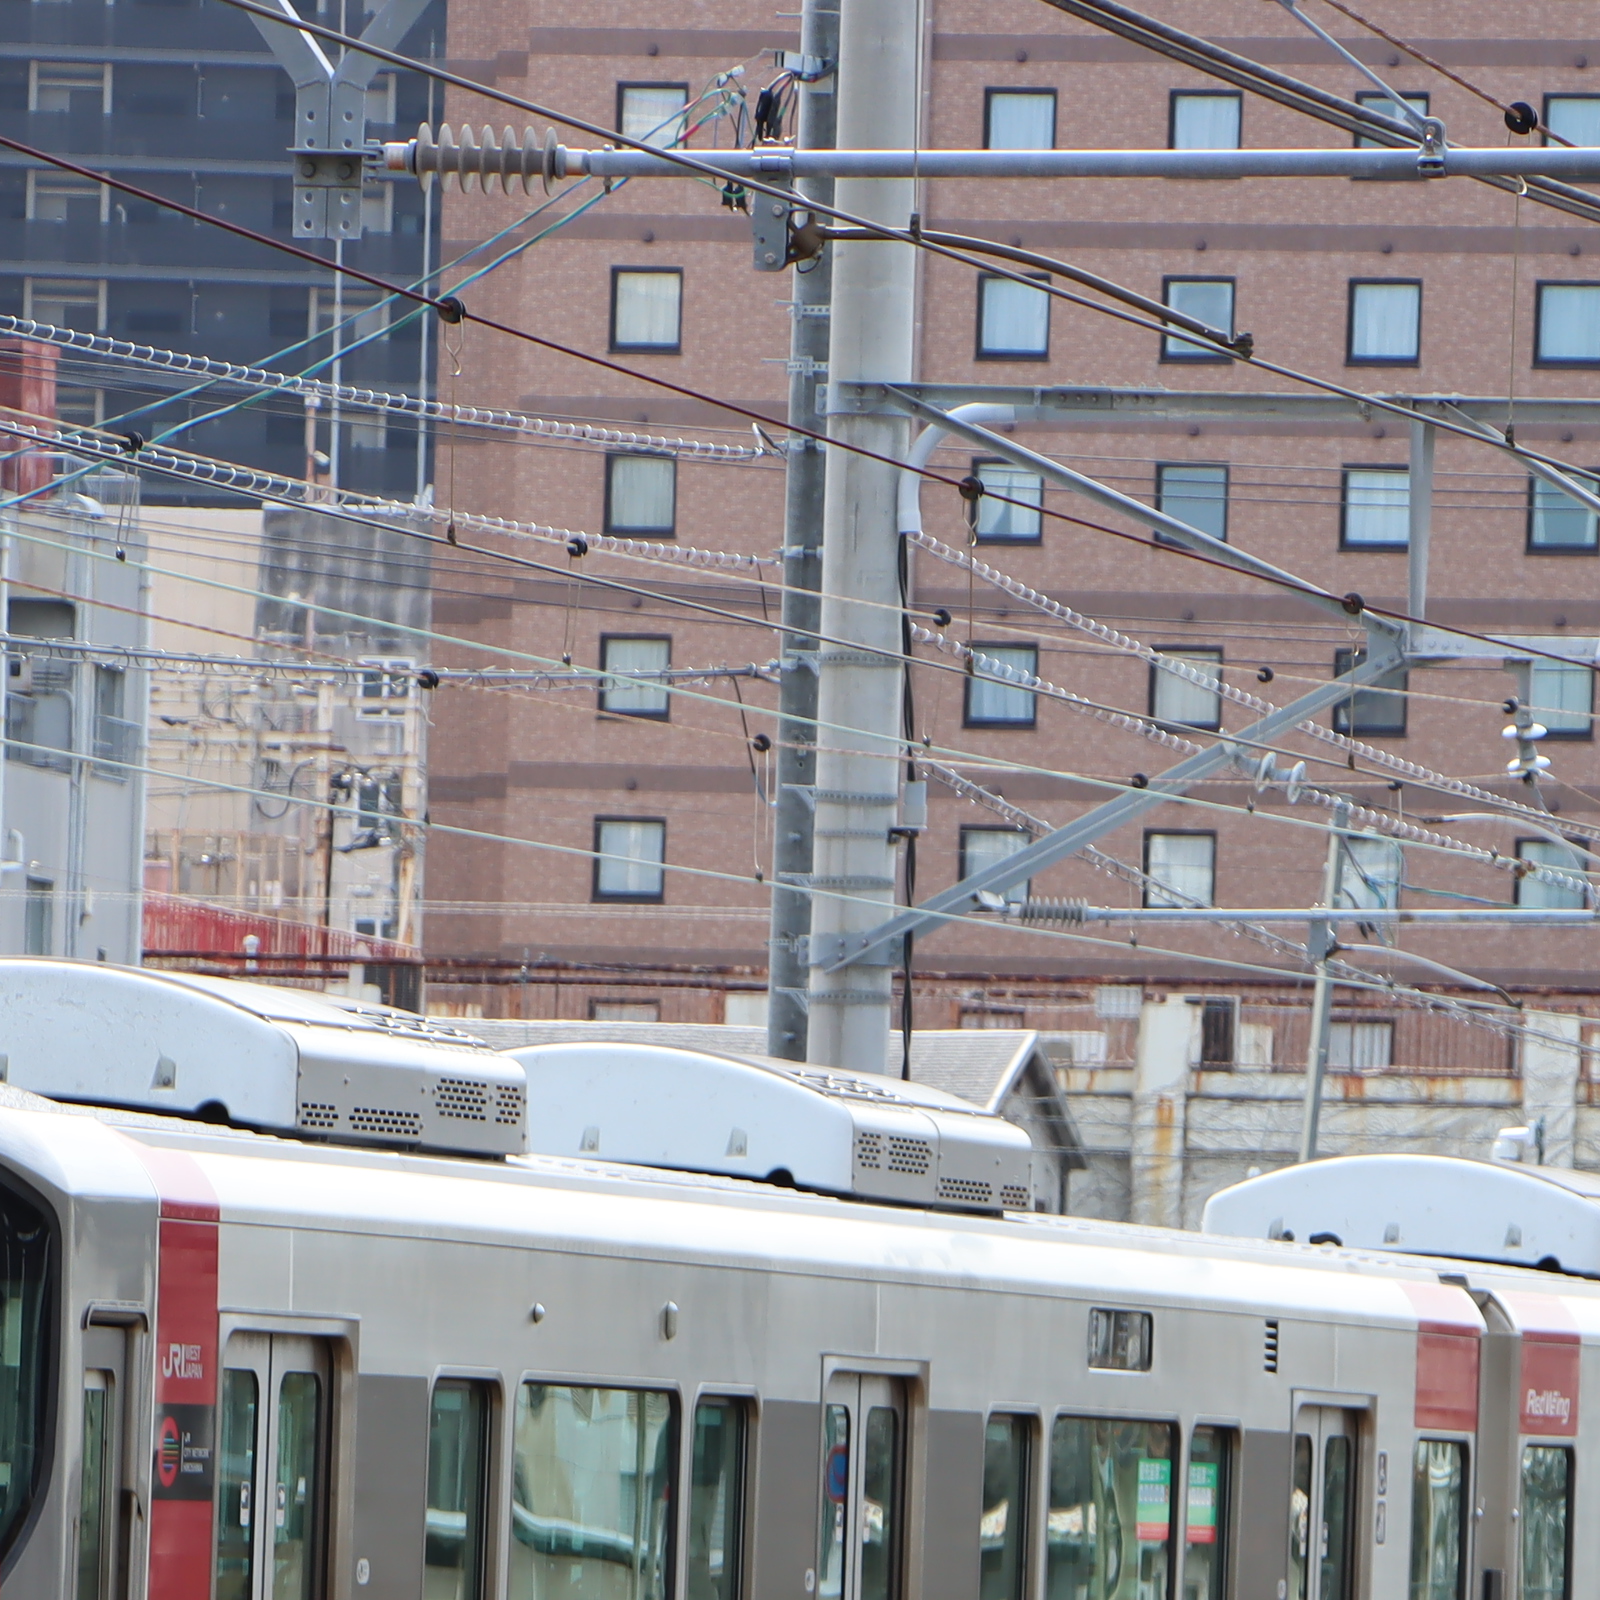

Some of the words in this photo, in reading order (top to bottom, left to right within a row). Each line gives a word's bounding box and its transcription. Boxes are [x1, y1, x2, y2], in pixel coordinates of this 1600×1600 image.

[184, 1344, 202, 1360] WEST
[163, 1343, 181, 1378] JR
[184, 1363, 203, 1379] JAPAN
